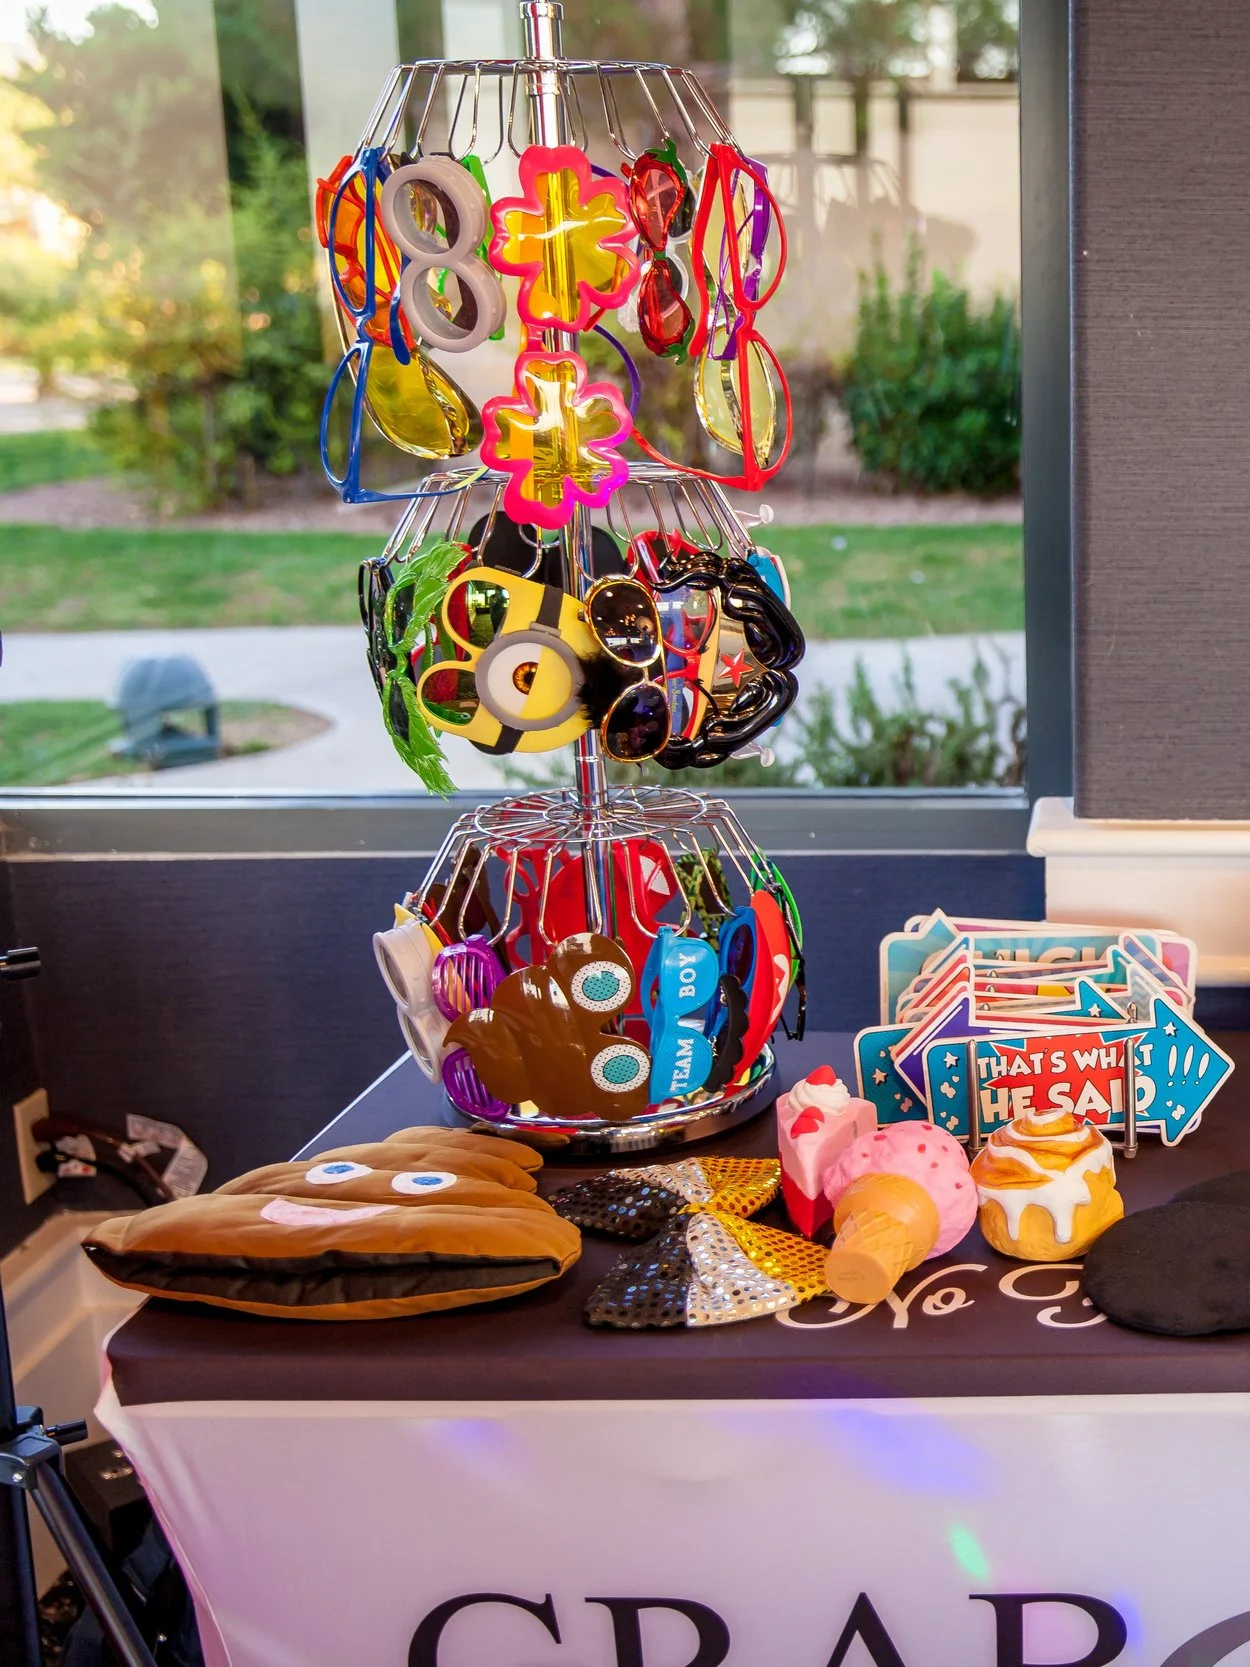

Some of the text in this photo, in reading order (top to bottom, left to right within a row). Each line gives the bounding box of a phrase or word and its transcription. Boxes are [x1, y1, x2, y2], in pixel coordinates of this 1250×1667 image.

[669, 953, 697, 1092] TEAM BOY
[977, 1048, 1068, 1080] THAT'S
[979, 1075, 1157, 1124] HE SAID
